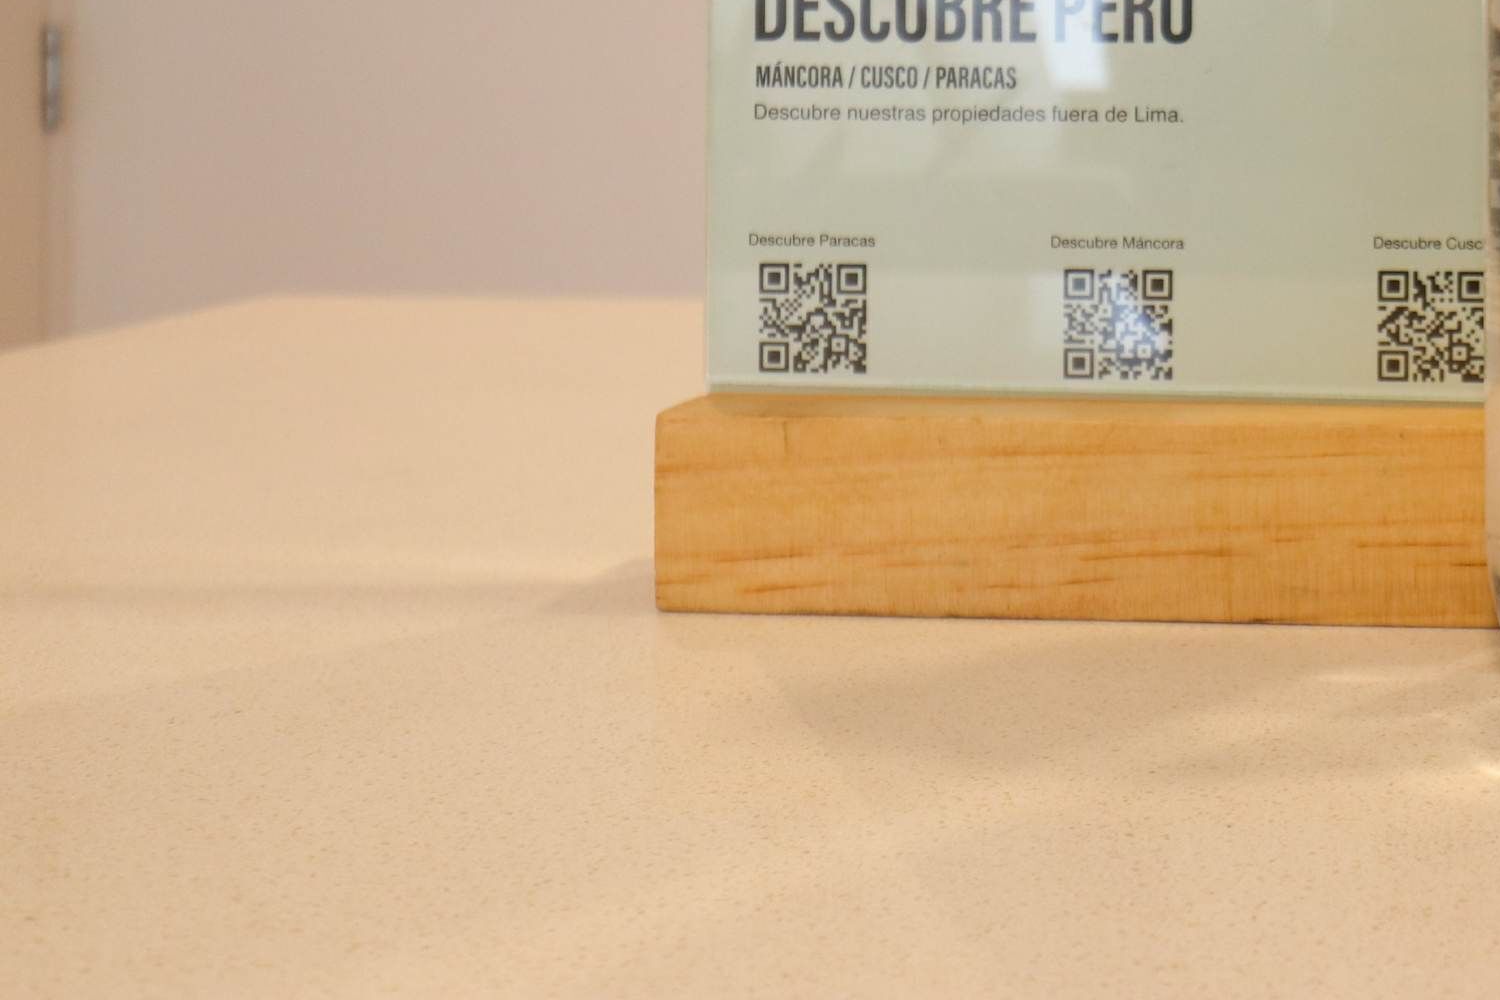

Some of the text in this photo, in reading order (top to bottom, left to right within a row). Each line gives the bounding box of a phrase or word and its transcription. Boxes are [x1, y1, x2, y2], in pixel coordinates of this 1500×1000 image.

[755, 61, 843, 89] MÁNCORA
[860, 65, 918, 89] CUSCO
[935, 65, 1018, 90] PARACAS
[753, 104, 1185, 127] Descubre nuestras propiedades fuera de Lima.
[748, 233, 876, 248] Descubre Paracas
[1050, 235, 1185, 251] Descubre Máncora
[1373, 236, 1484, 250] Descubre Cusc
